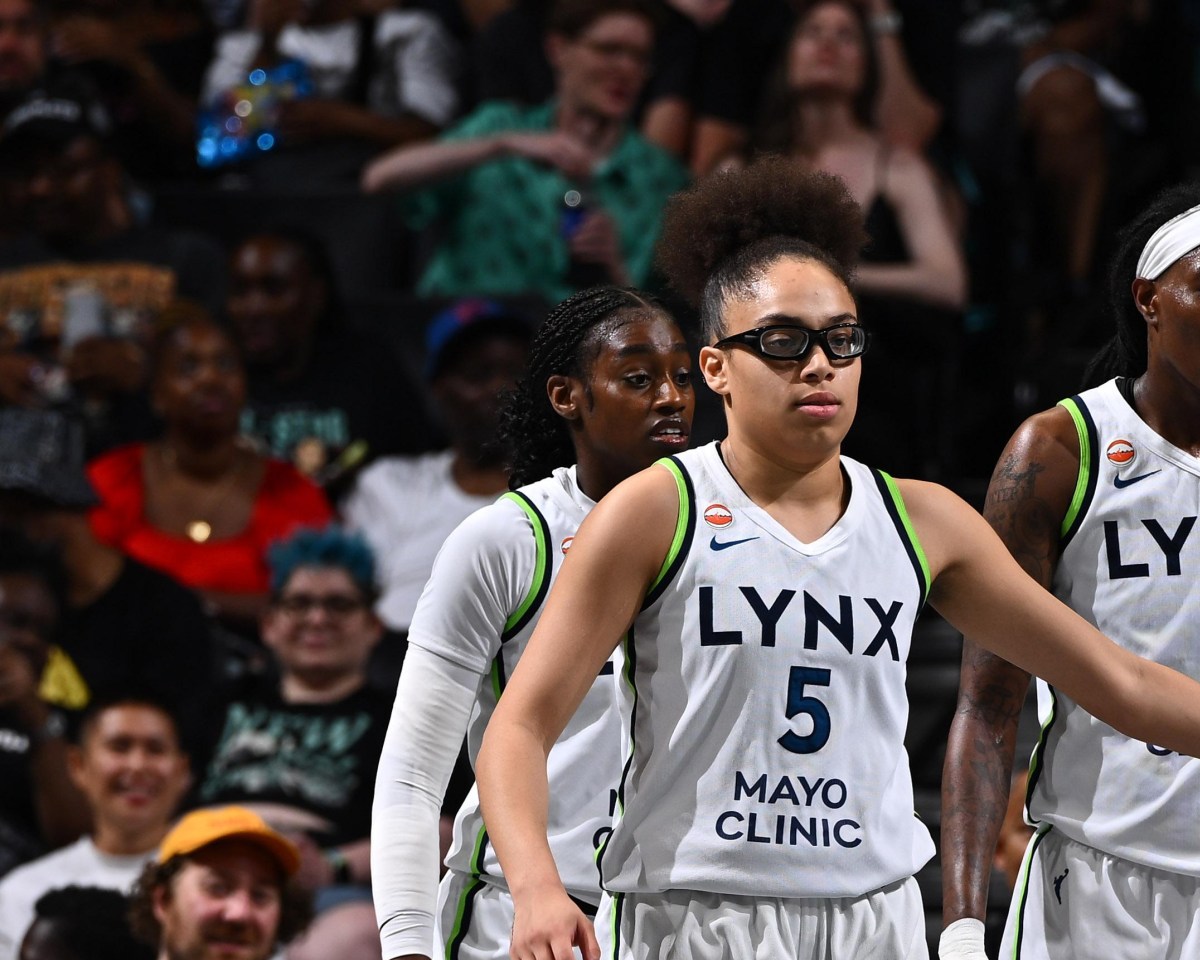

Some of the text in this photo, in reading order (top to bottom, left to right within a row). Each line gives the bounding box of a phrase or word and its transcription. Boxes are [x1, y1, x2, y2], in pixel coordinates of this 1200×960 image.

[699, 586, 904, 662] LYNX
[777, 665, 832, 755] 5
[734, 771, 847, 809] MAYO
[715, 811, 862, 848] CLINIC
